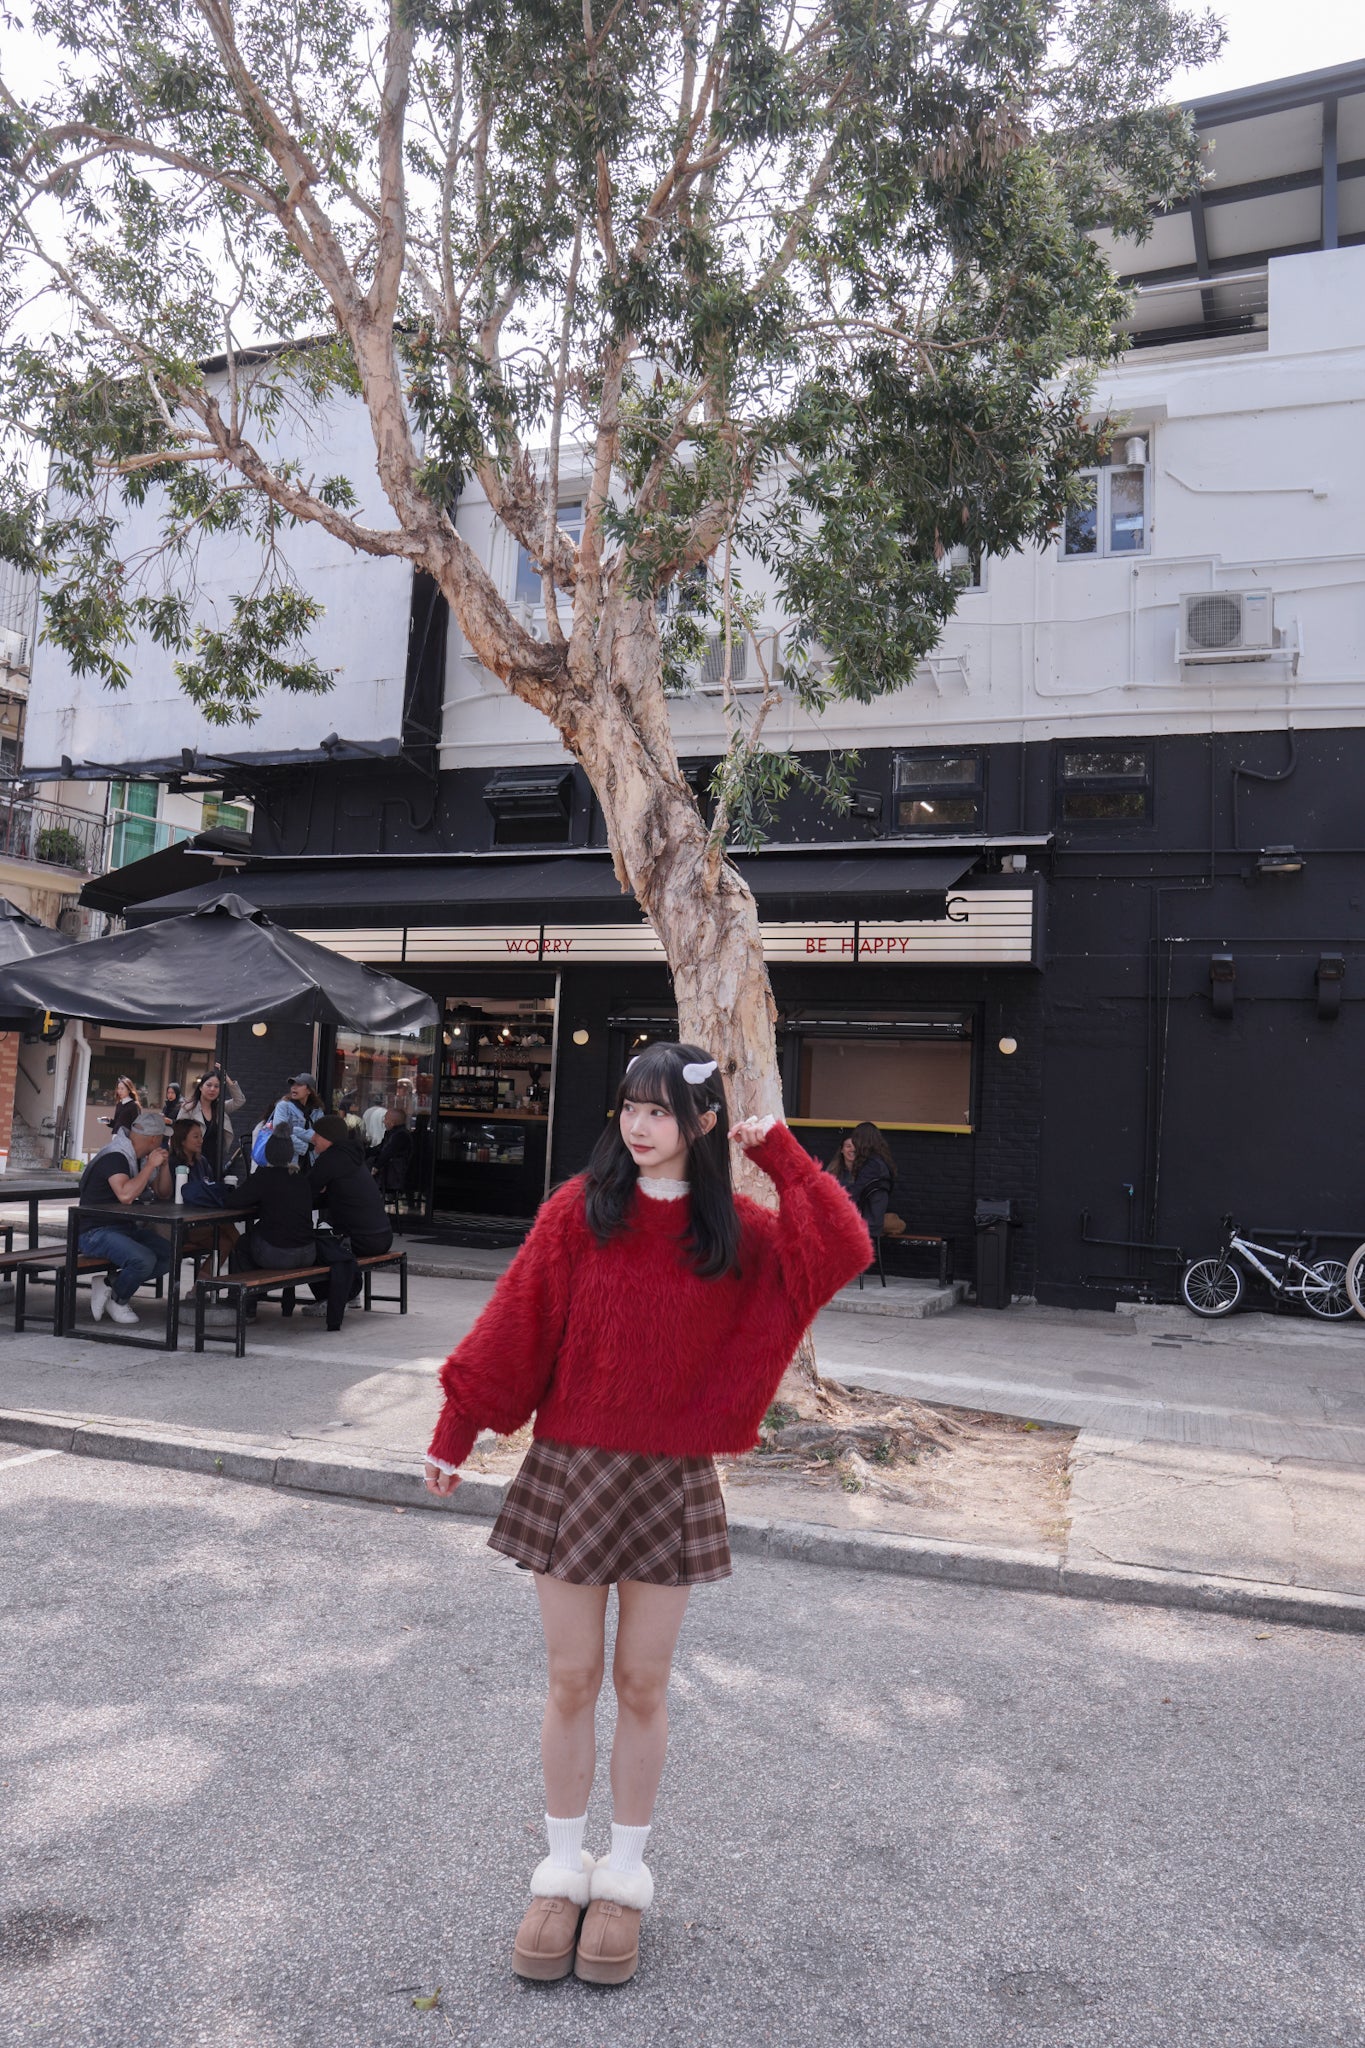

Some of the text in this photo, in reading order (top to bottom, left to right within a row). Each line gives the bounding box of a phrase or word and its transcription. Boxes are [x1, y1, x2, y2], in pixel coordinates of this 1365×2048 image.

[506, 938, 910, 954] WORRY BE HAPPY
